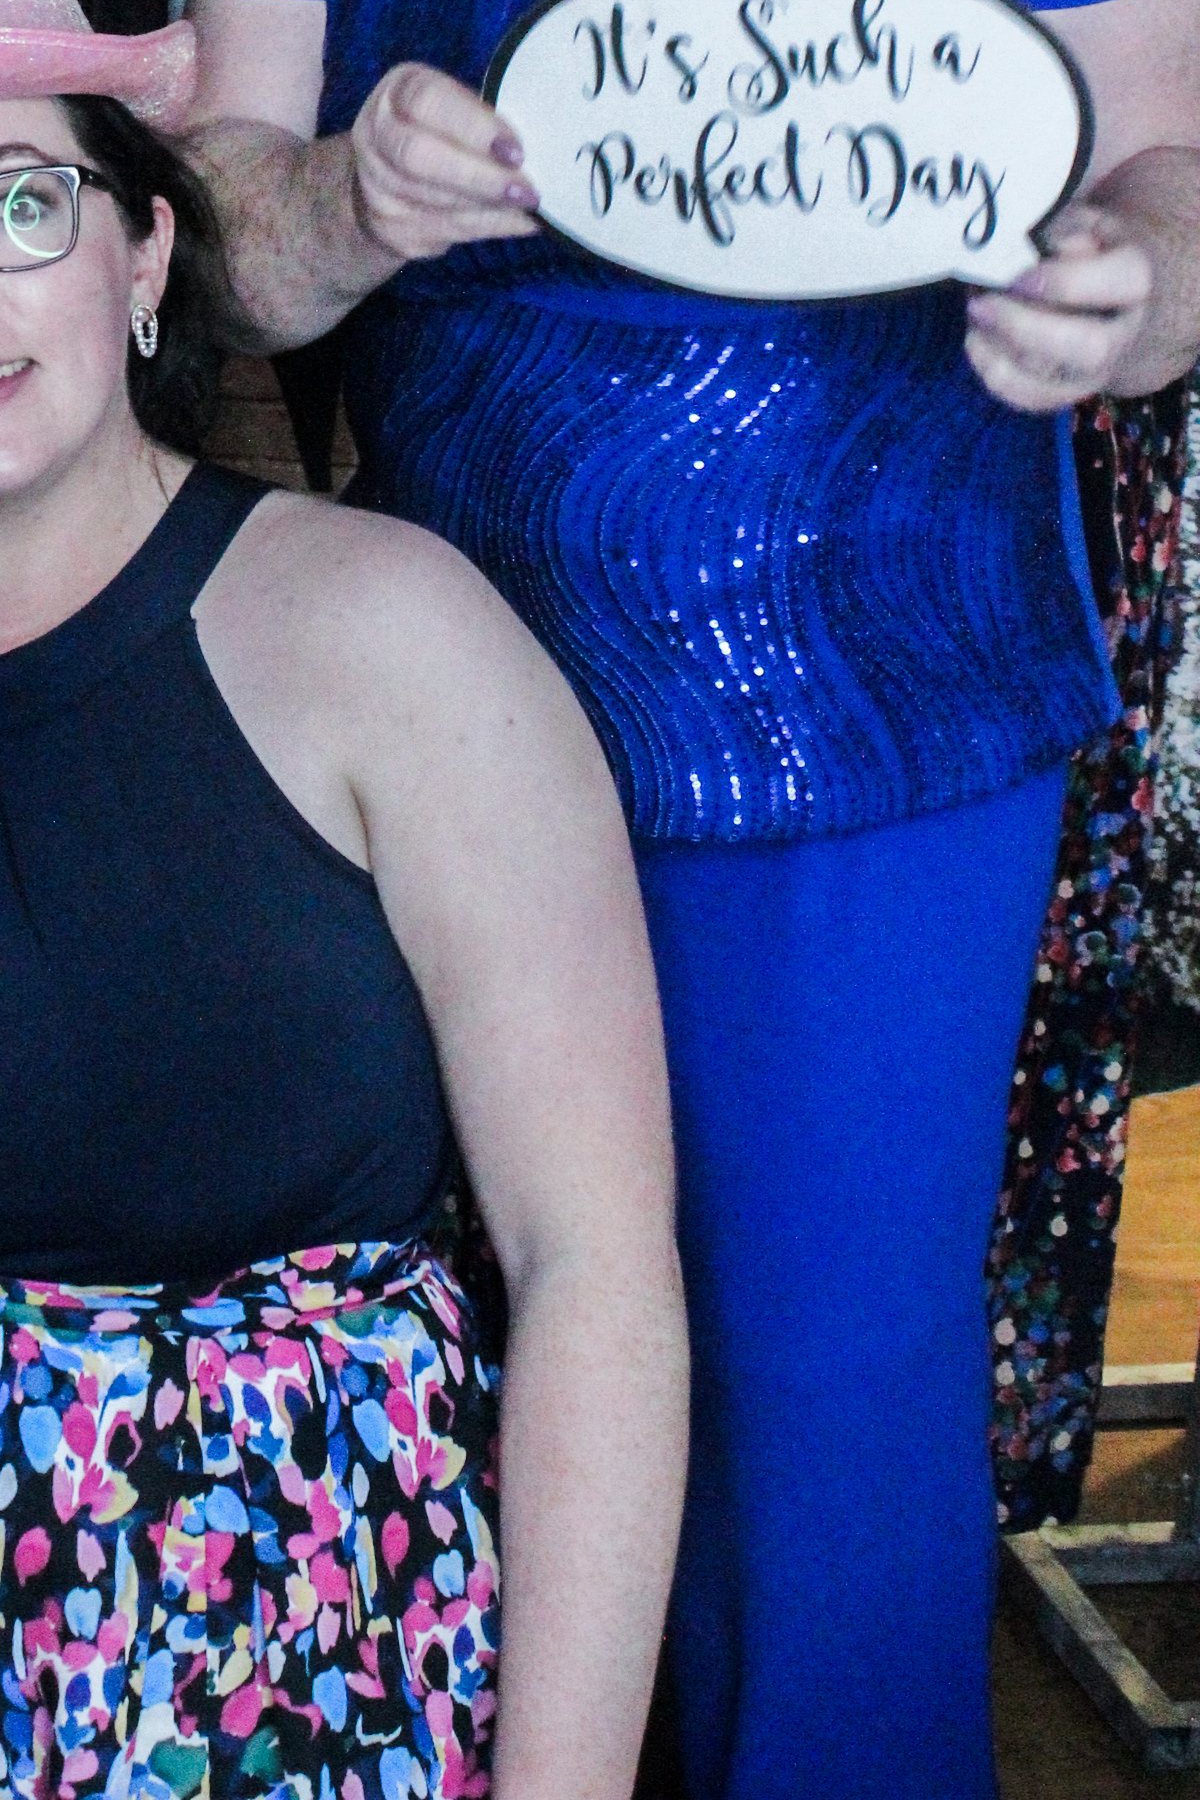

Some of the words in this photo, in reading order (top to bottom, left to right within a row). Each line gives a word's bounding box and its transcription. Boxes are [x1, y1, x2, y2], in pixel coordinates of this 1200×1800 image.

[573, 1, 709, 103] It's
[932, 30, 981, 85] a
[576, 110, 822, 248] Perfect
[825, 122, 1006, 250] Day
